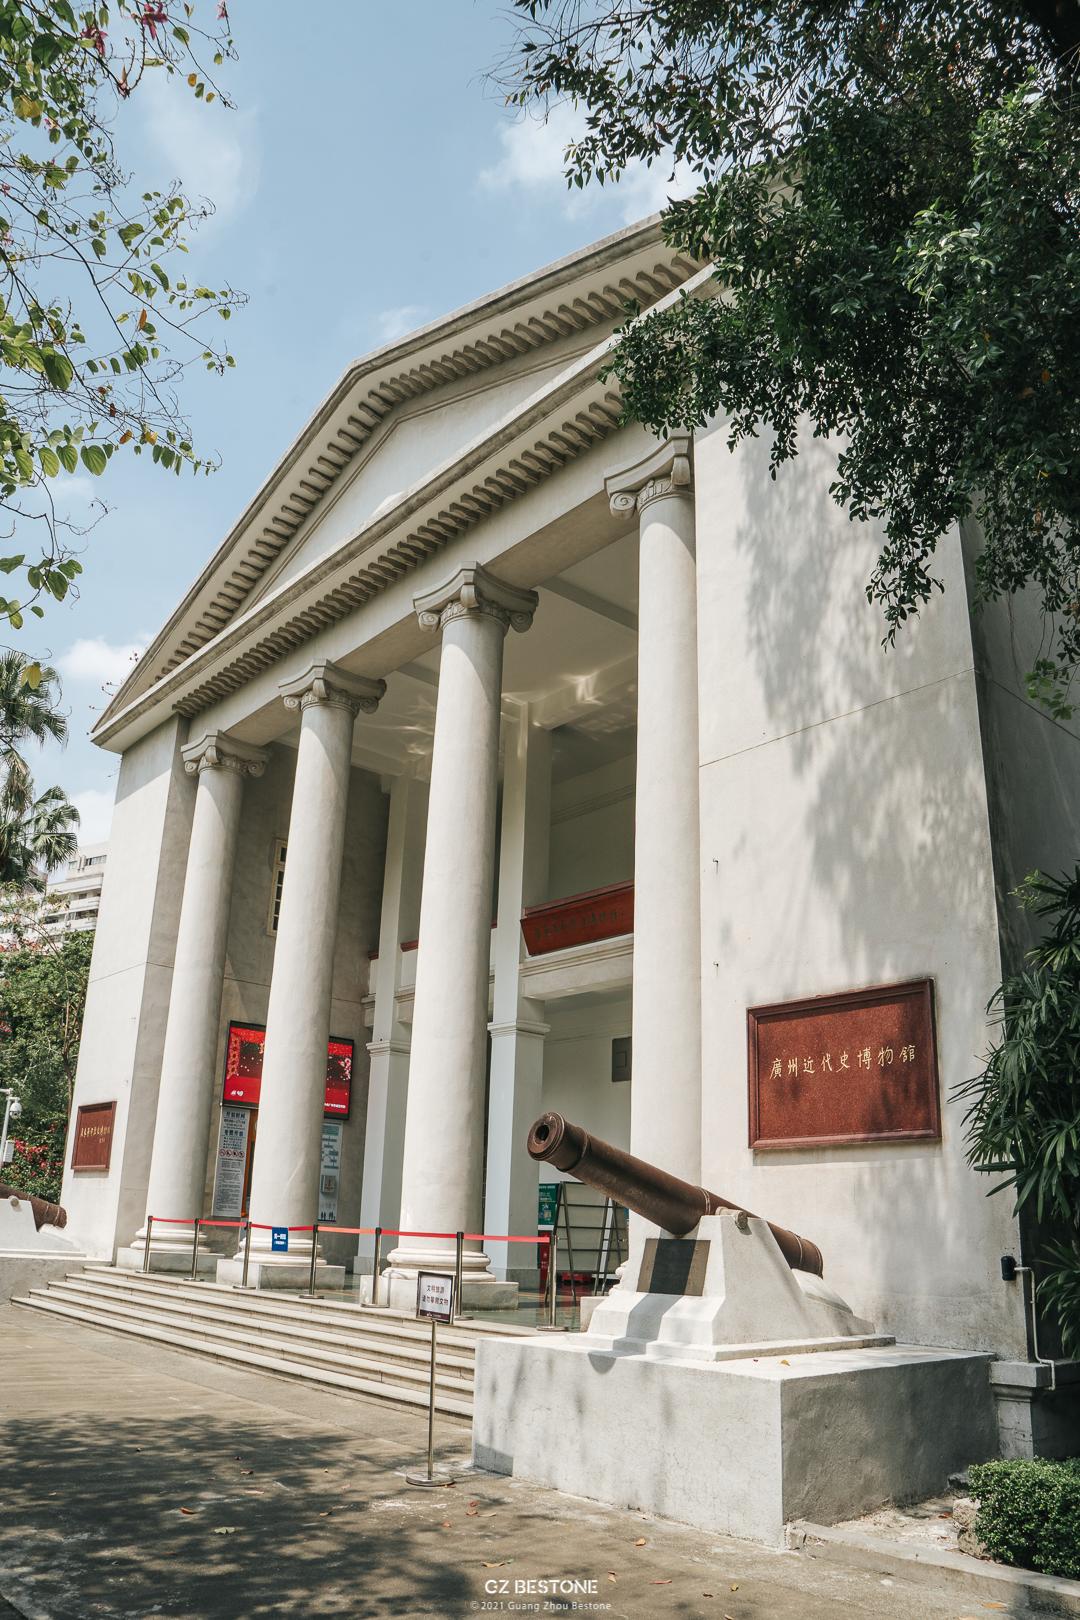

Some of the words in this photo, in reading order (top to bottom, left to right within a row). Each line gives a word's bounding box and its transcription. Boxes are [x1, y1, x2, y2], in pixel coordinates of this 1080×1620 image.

[769, 1044, 916, 1079] 廣州近代史博物館
